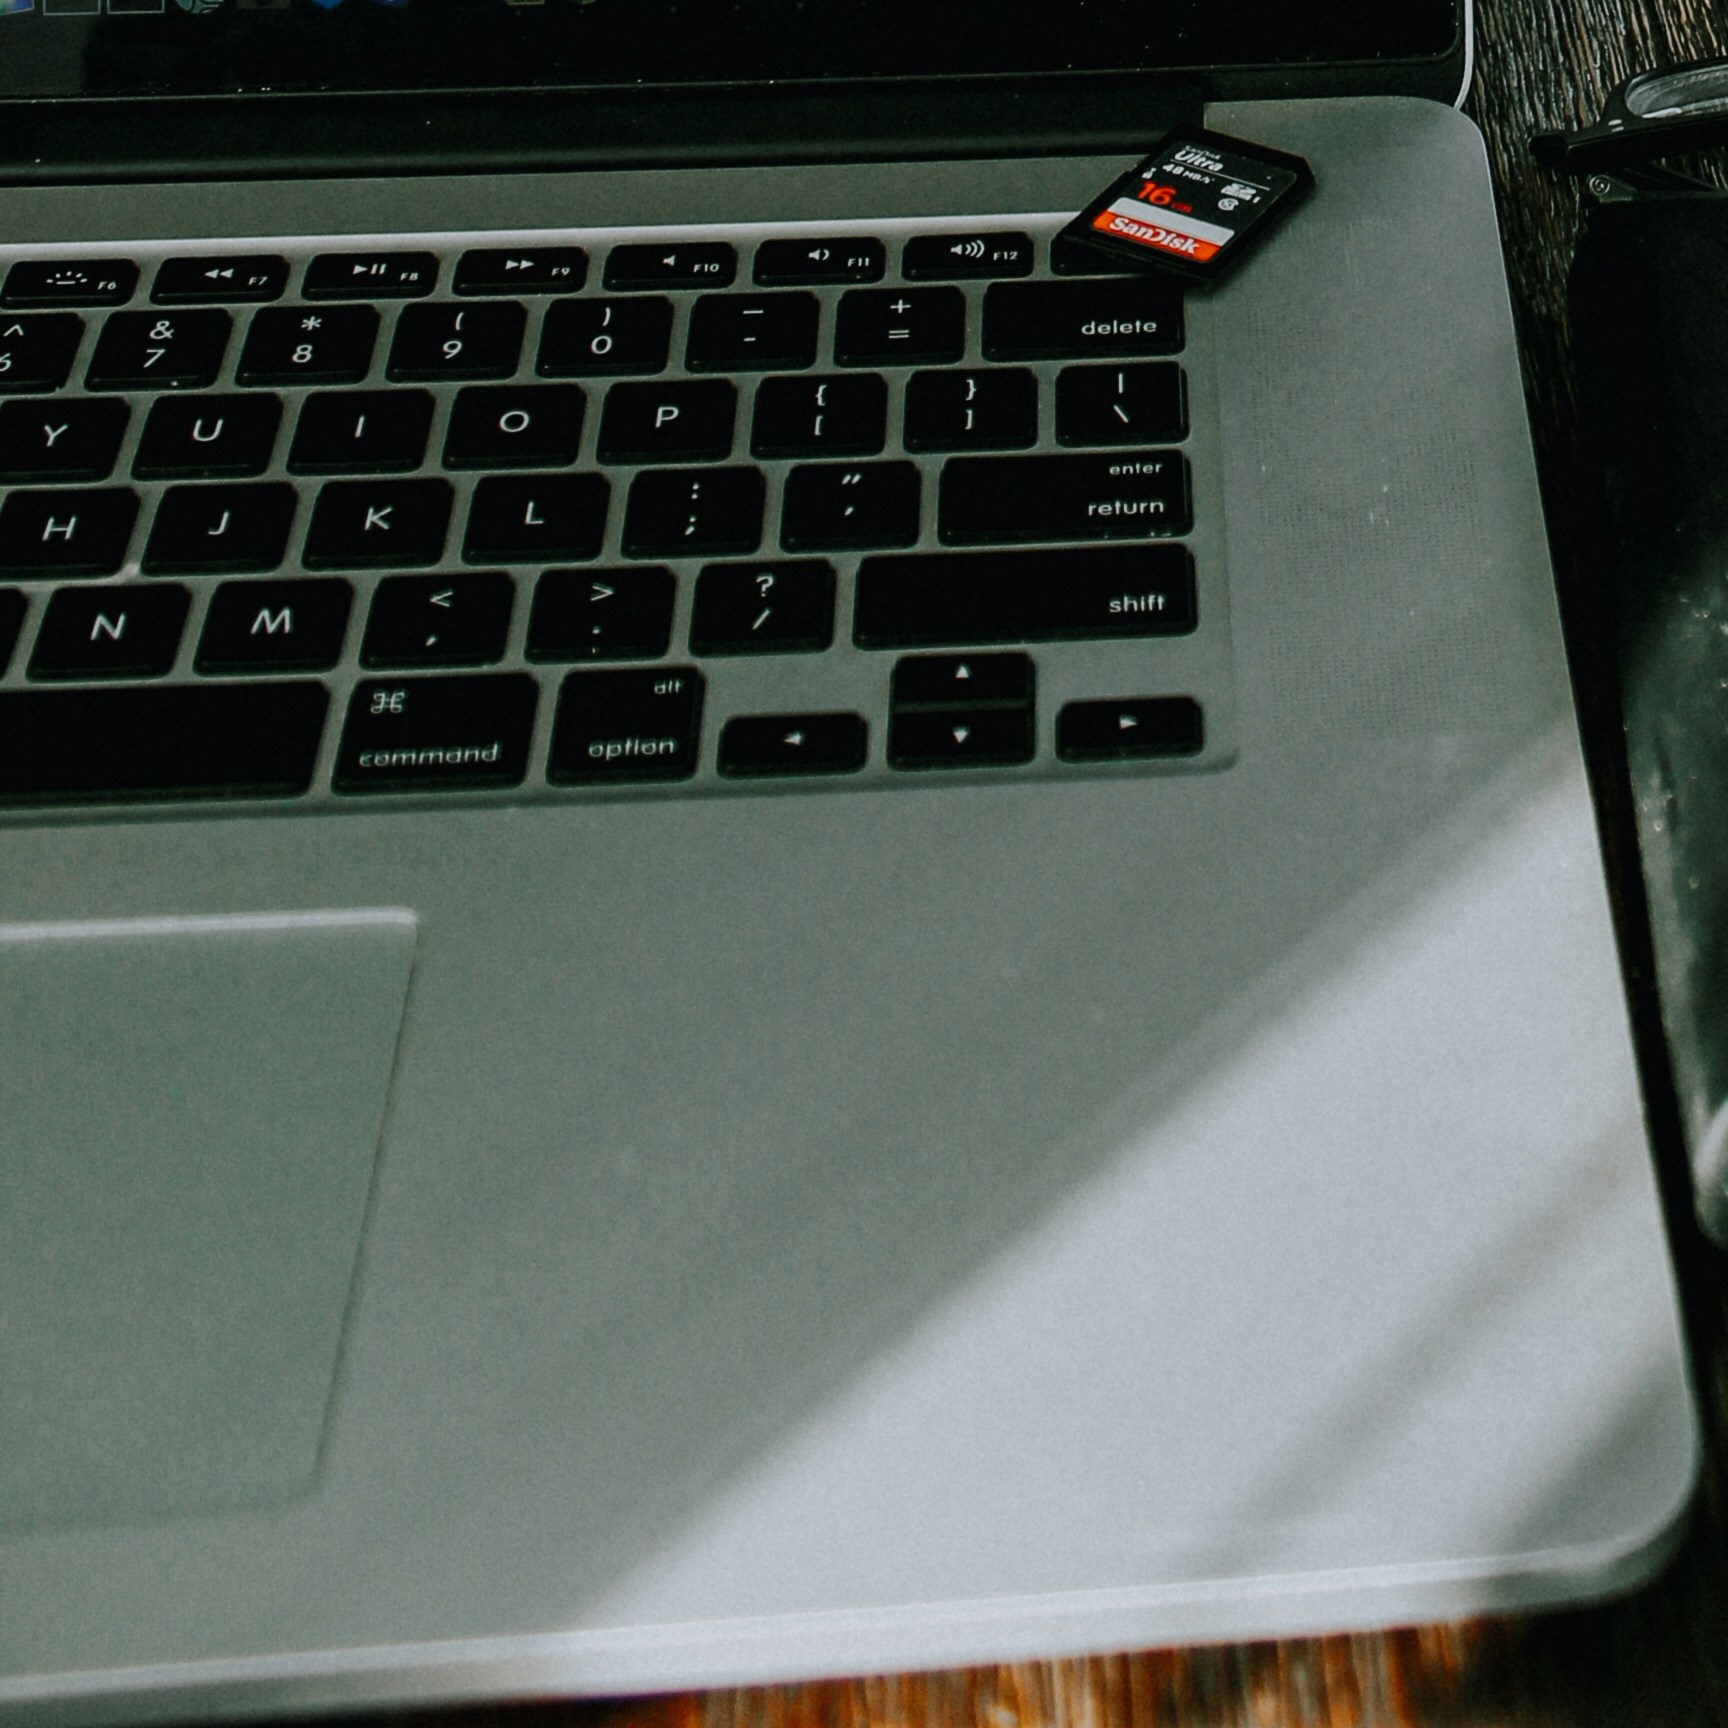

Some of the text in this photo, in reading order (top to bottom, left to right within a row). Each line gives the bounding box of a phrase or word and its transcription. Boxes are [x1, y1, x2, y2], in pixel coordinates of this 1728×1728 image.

[1174, 150, 1223, 172] Ultra
[1138, 181, 1177, 206] 16
[1109, 217, 1199, 255] SanDisk
[848, 258, 869, 266] F11
[993, 251, 1017, 260] F12
[694, 264, 719, 272] F10
[98, 282, 116, 290] F6
[249, 276, 267, 285] F7
[1082, 320, 1156, 334] delete
[144, 349, 165, 367] 7
[292, 345, 312, 363] 8
[443, 340, 462, 359] 9
[656, 407, 679, 427] P
[44, 425, 67, 446] Y
[193, 419, 223, 441] U
[1110, 463, 1161, 474] enter
[525, 502, 543, 524] L
[1089, 501, 1164, 515] return
[209, 512, 229, 535] J
[365, 507, 392, 530] K
[43, 517, 76, 540] H
[1110, 595, 1164, 612] shift
[91, 614, 125, 640] N
[251, 608, 290, 633] M
[654, 680, 681, 694] alt
[360, 744, 498, 765] command
[589, 740, 674, 759] option
